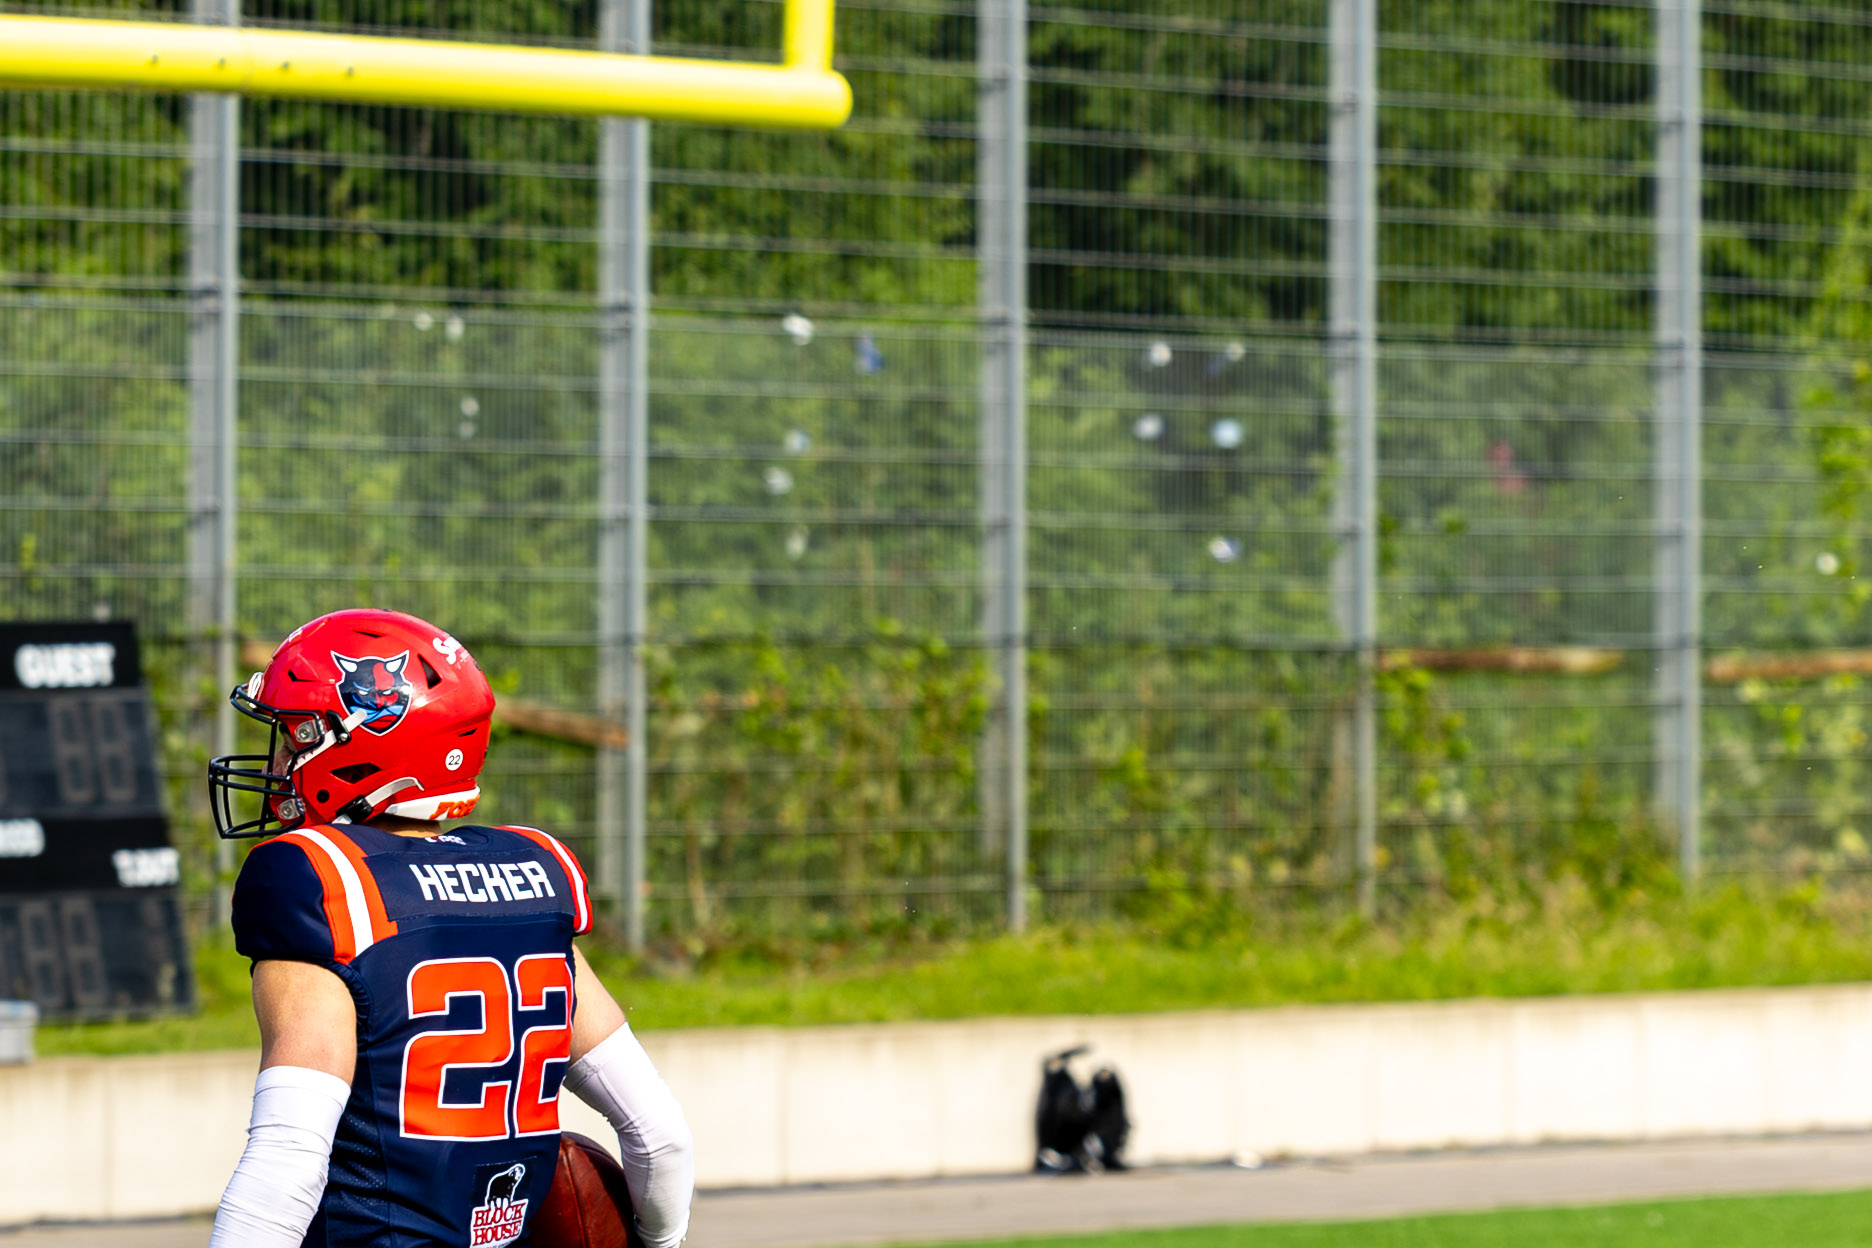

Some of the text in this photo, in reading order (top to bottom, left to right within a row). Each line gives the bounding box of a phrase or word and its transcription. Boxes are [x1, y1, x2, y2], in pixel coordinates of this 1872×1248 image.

[15, 643, 115, 688] GUEST
[448, 754, 461, 766] 22
[409, 861, 556, 903] HECKER
[399, 952, 574, 1142] 22
[473, 1202, 526, 1227] BLOCK
[472, 1220, 522, 1247] HOUSE
